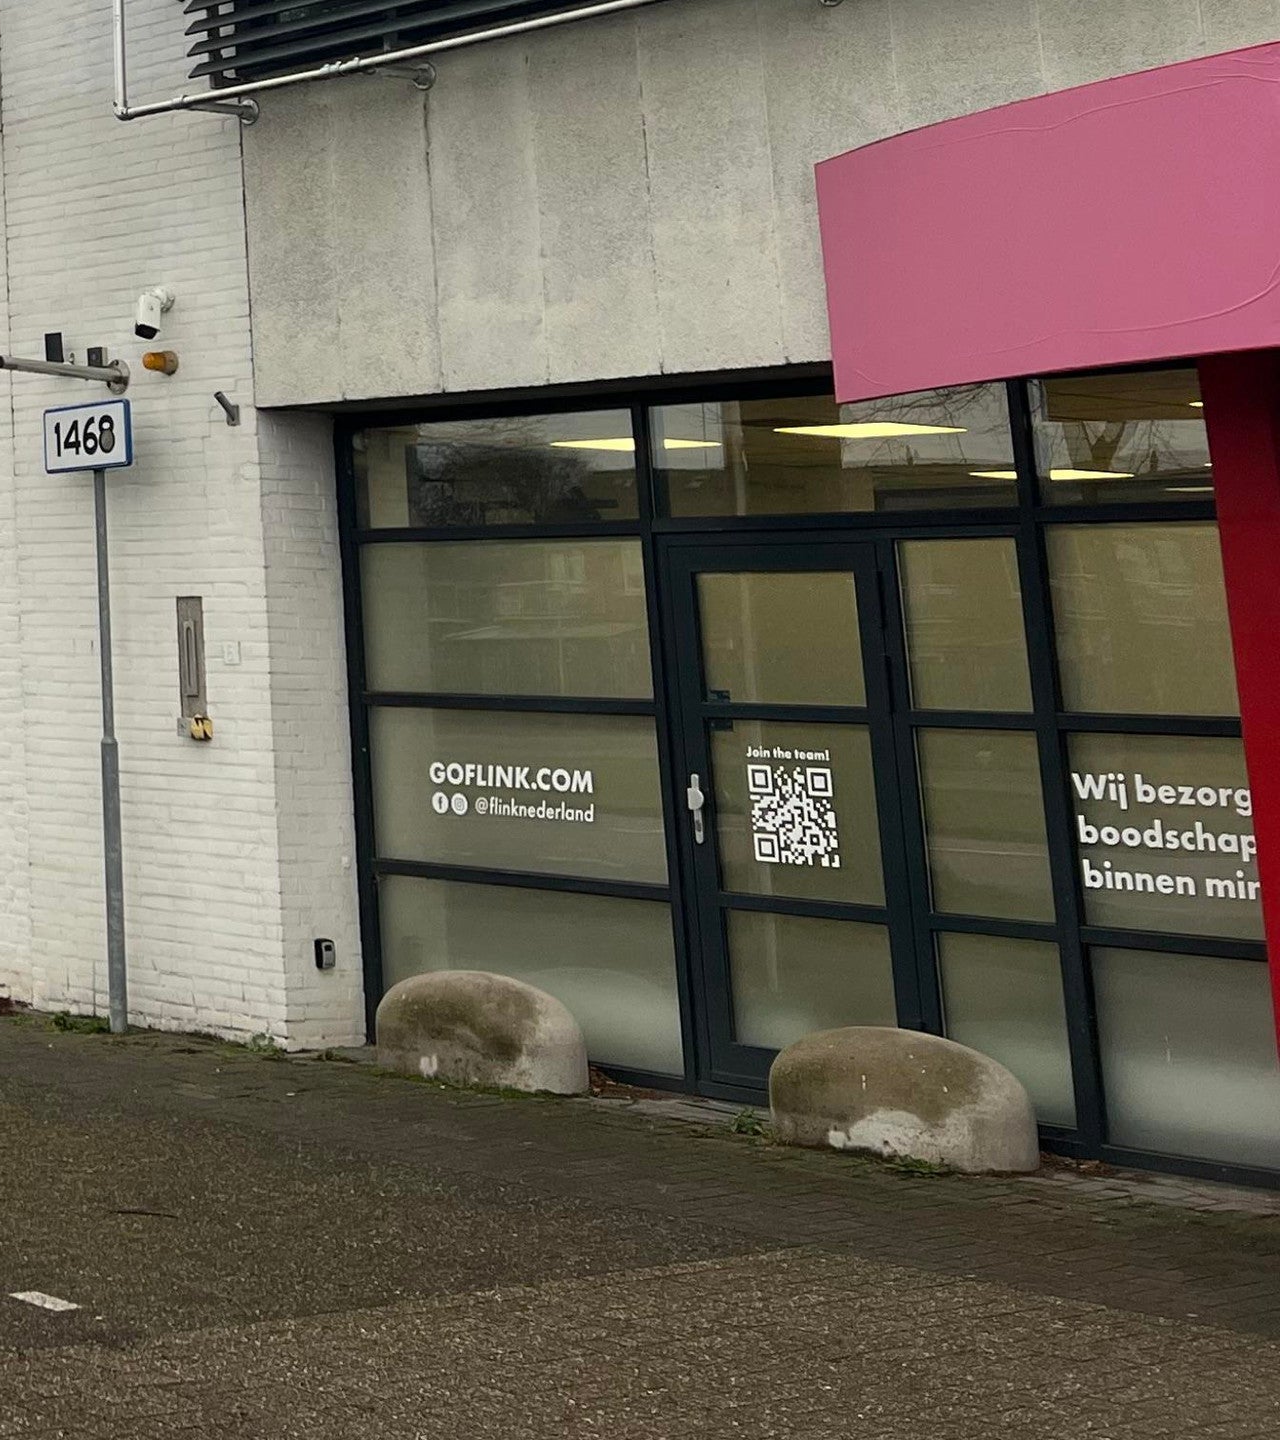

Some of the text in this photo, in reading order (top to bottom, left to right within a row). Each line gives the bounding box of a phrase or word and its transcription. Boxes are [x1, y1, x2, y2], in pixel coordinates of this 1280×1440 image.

[54, 414, 116, 458] 1468
[746, 746, 830, 761] Join the team!
[429, 762, 594, 793] GOFLINK.COM
[1071, 773, 1252, 816] Wij bezorg
[474, 796, 595, 823] @flinknederland
[1078, 815, 1256, 862] boodschap
[1082, 859, 1196, 896] binnen
